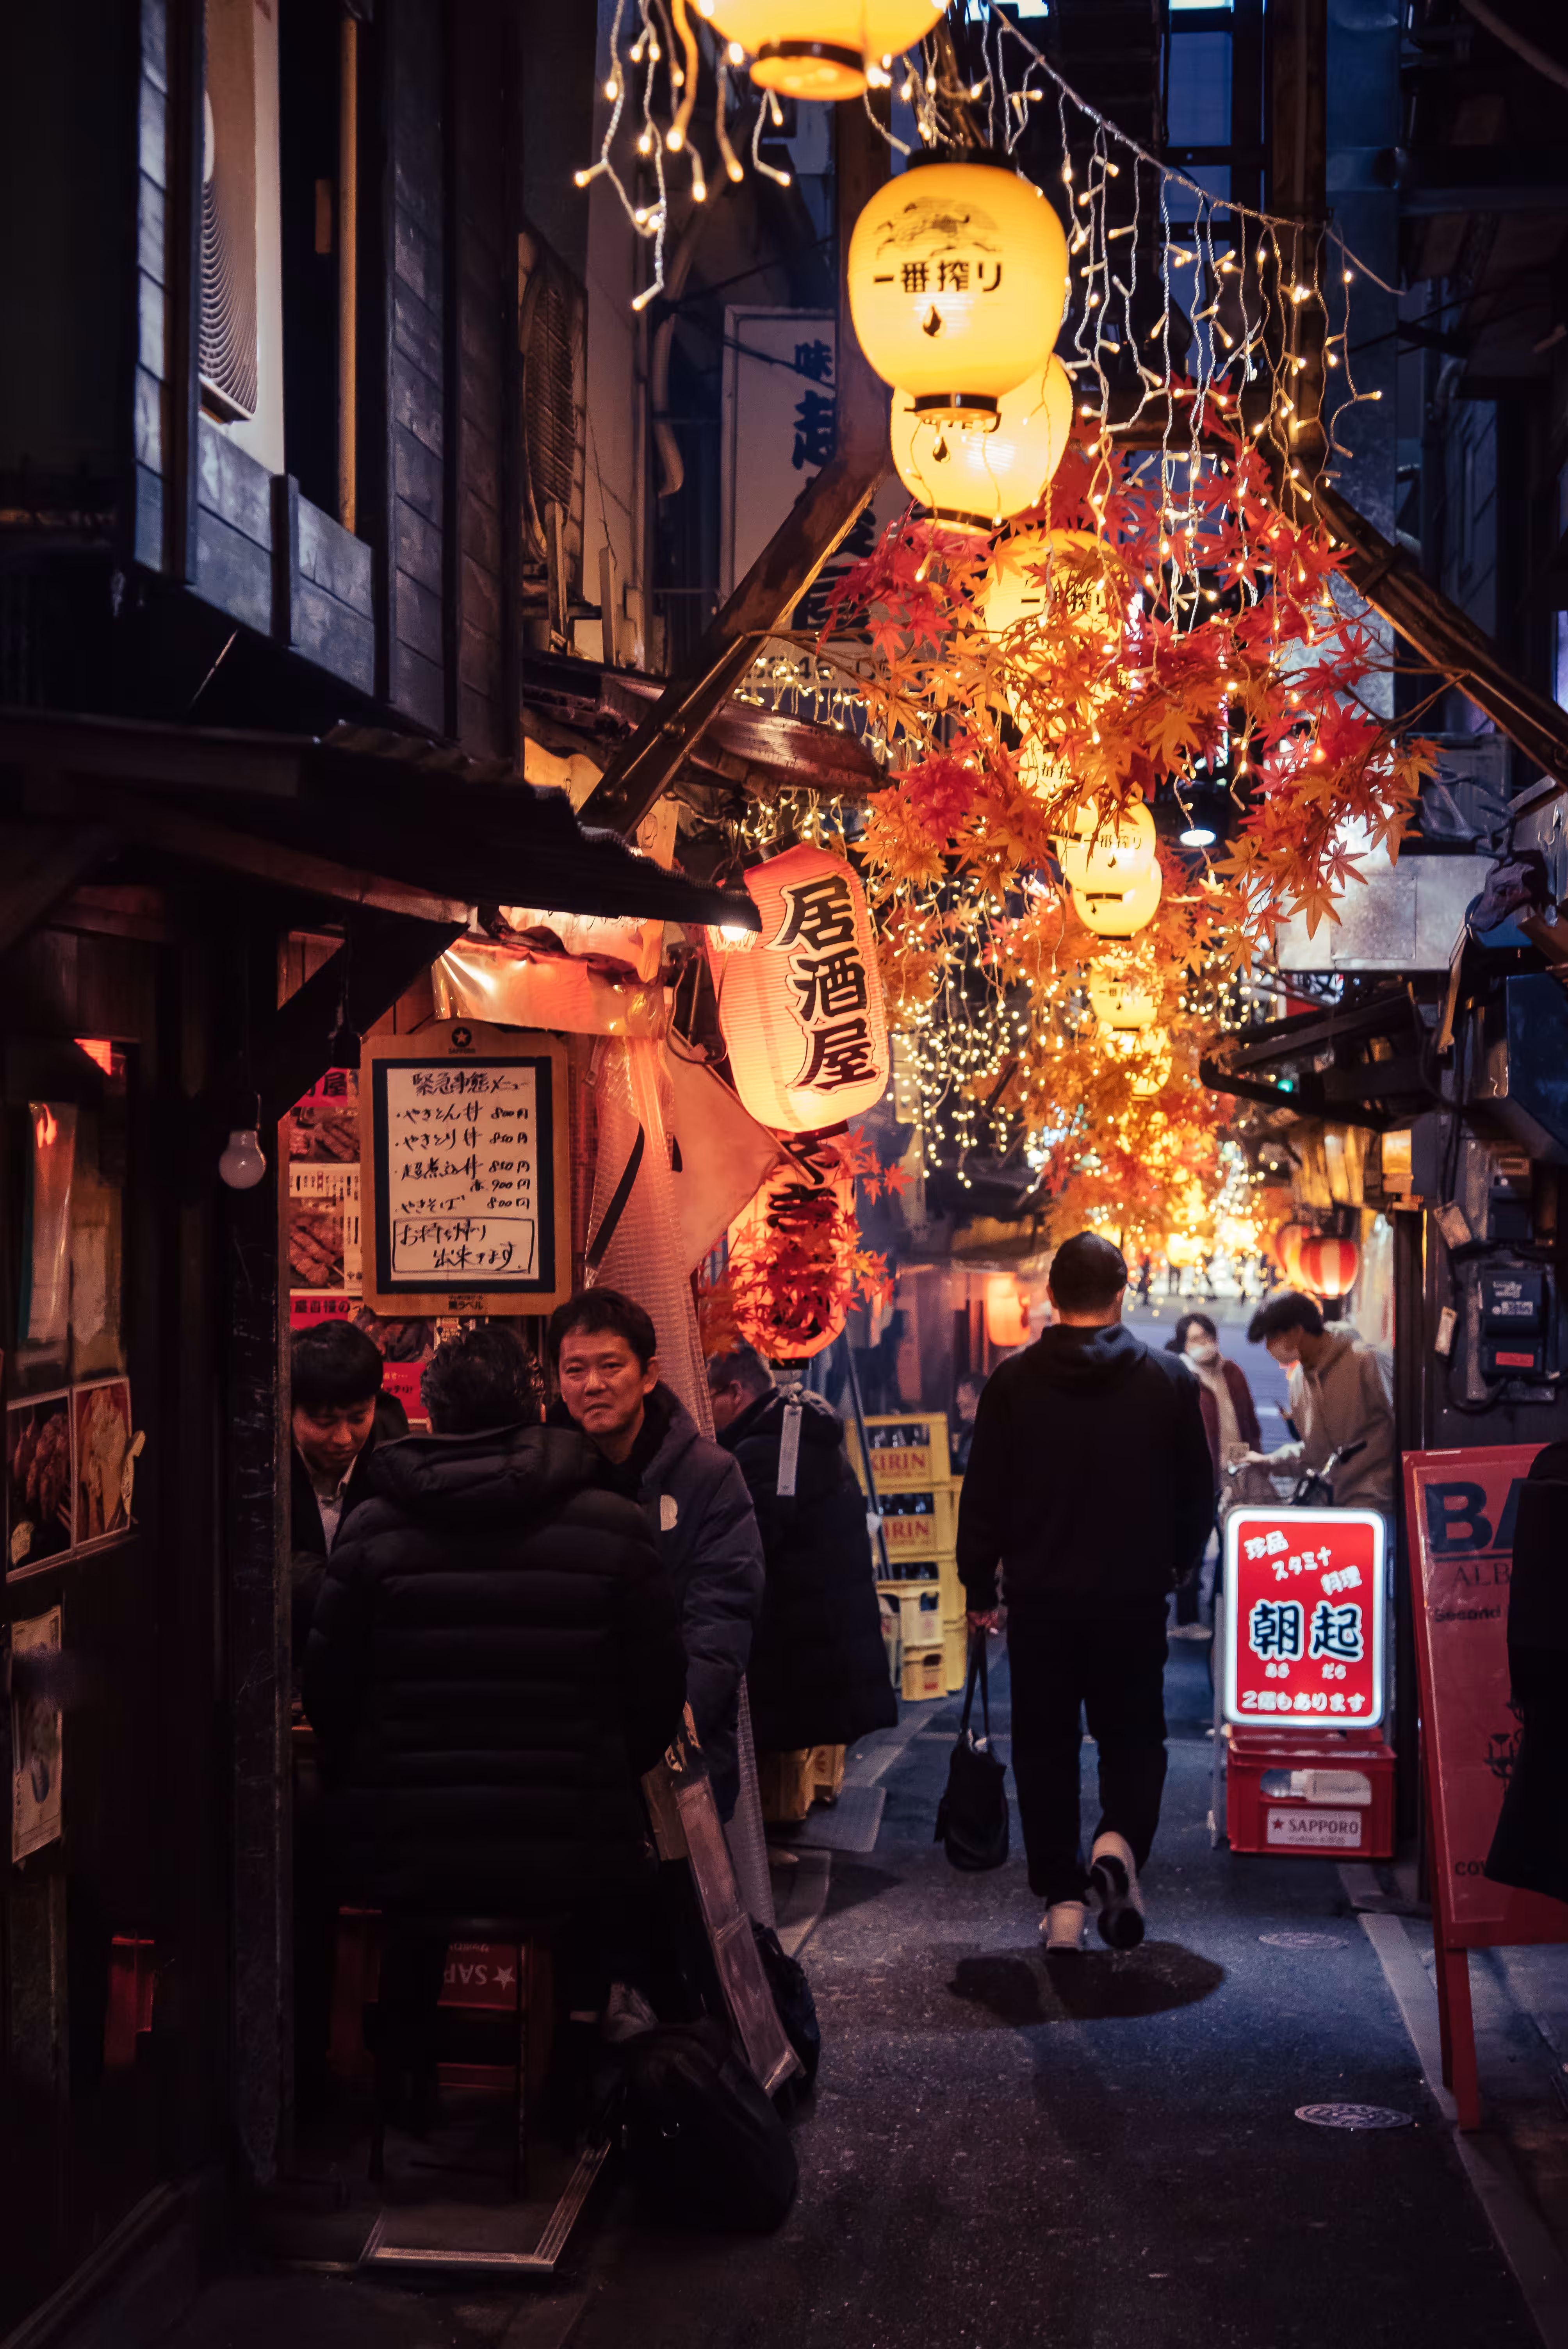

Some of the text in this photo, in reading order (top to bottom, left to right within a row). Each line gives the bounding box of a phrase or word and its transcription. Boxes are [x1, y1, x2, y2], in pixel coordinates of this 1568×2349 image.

[873, 260, 1002, 293] 一番搾り
[771, 874, 879, 1091] 居酒屋
[883, 1520, 930, 1538] IRIN
[1272, 1546, 1332, 1581] スタミナ
[1252, 1602, 1361, 1657] 朝起
[1288, 1818, 1359, 1835] SAPPORO
